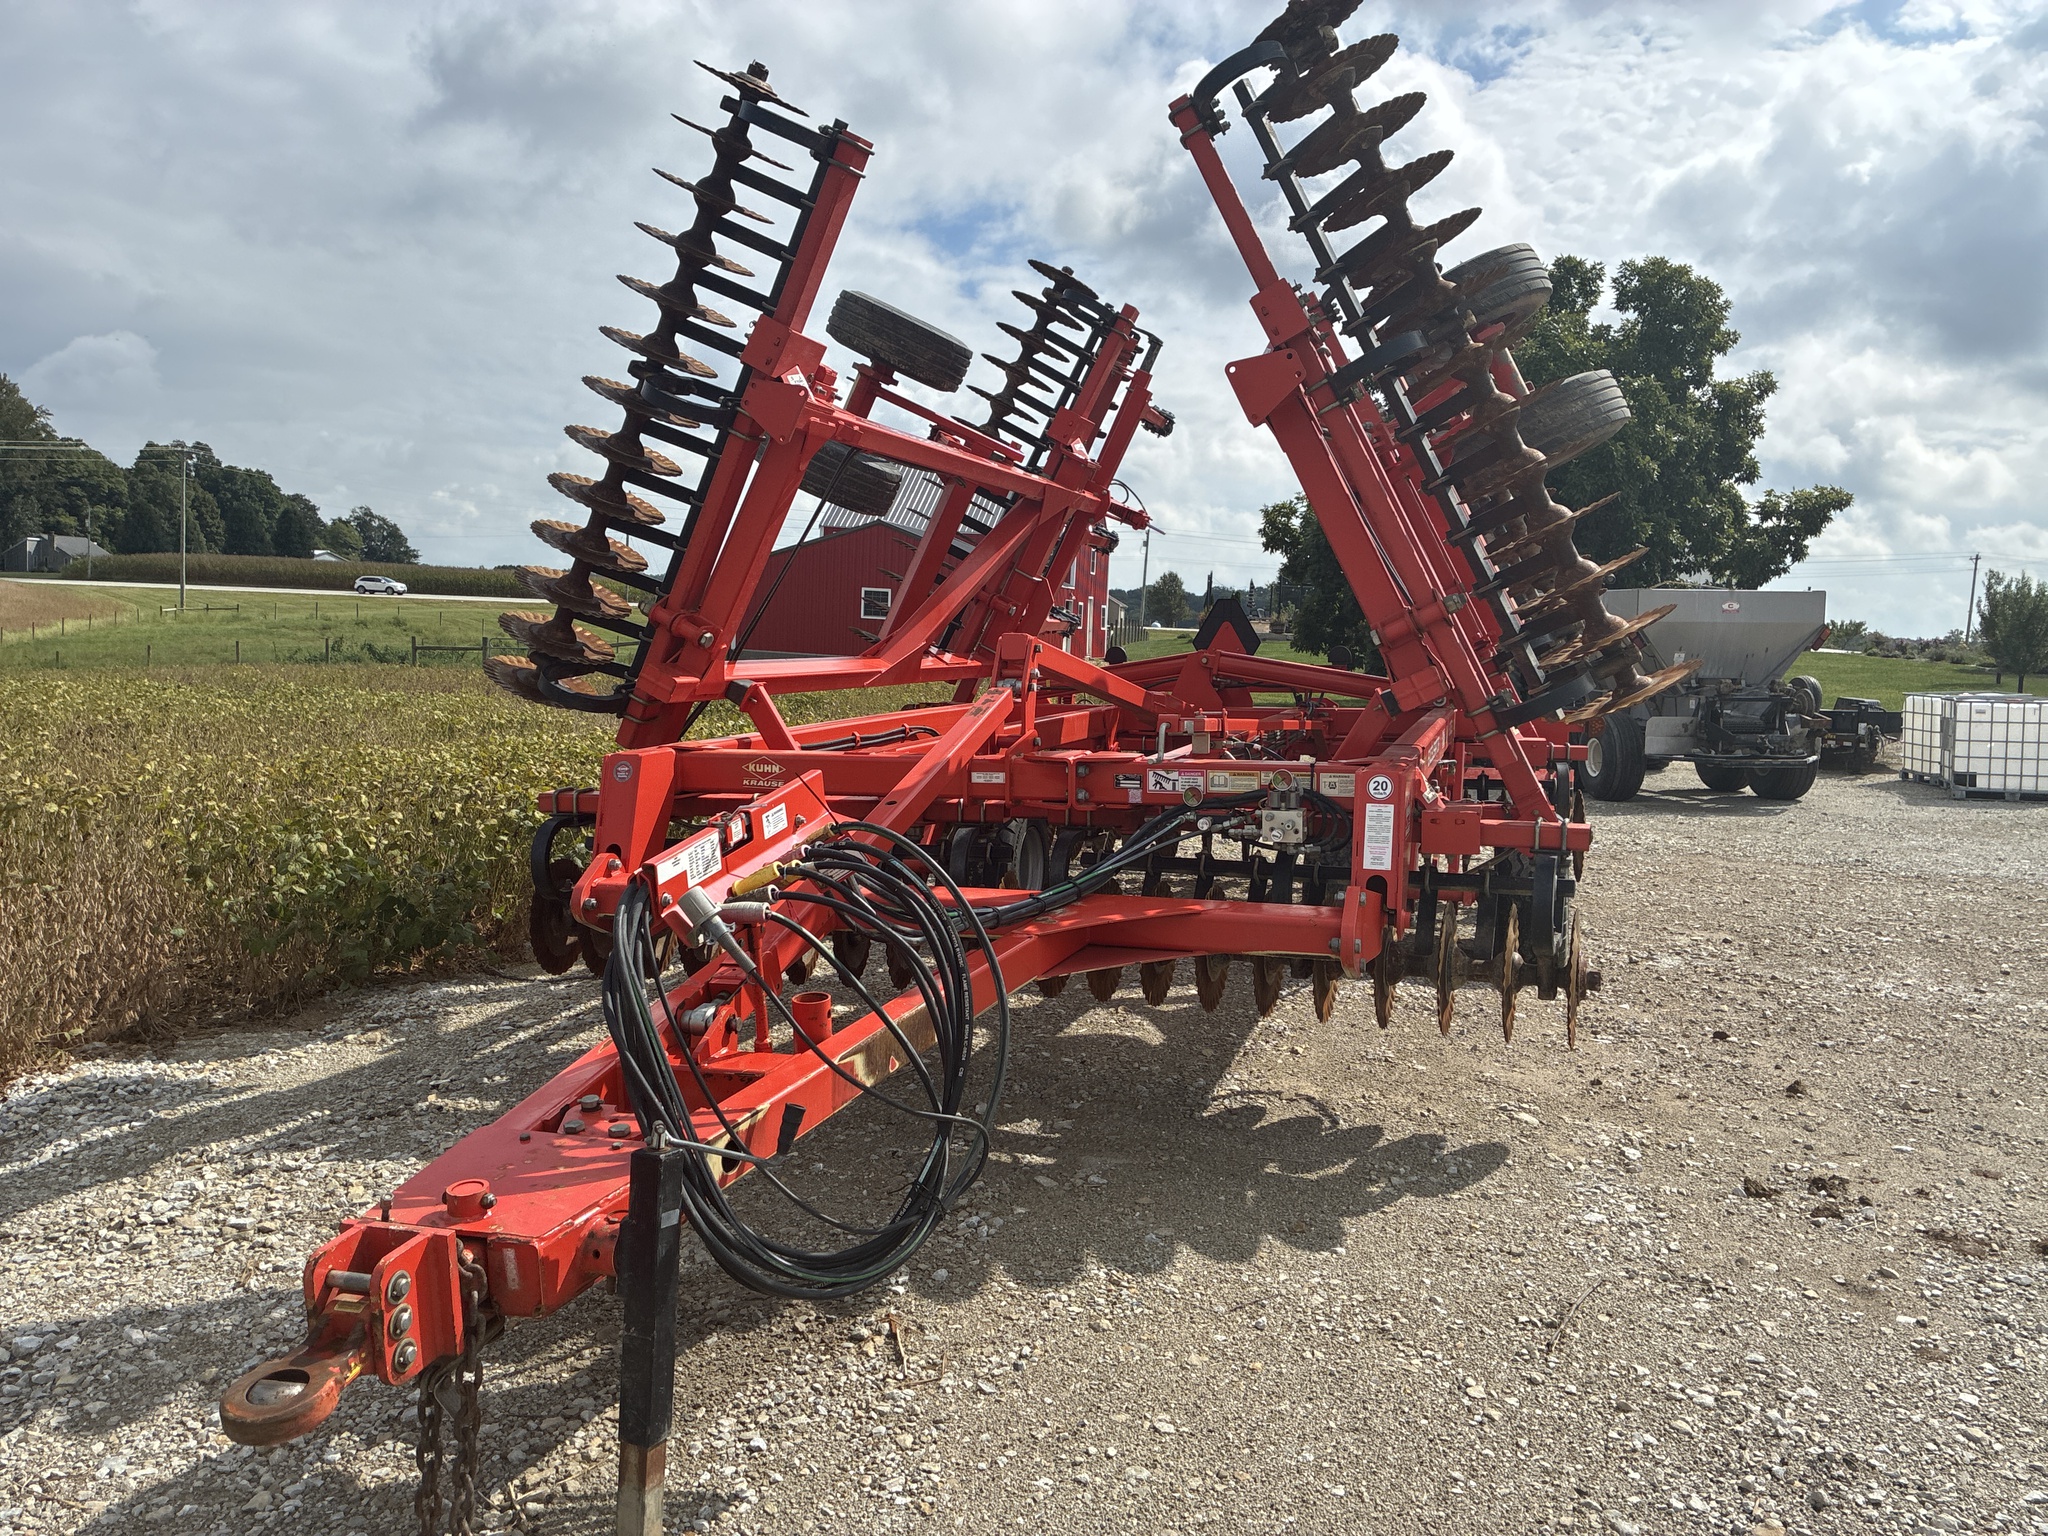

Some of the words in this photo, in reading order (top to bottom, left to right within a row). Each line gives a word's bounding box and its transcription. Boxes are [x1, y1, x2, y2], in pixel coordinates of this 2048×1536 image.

[748, 763, 780, 773] KUHN
[743, 779, 785, 787] KRAUSE
[1372, 780, 1388, 791] 20
